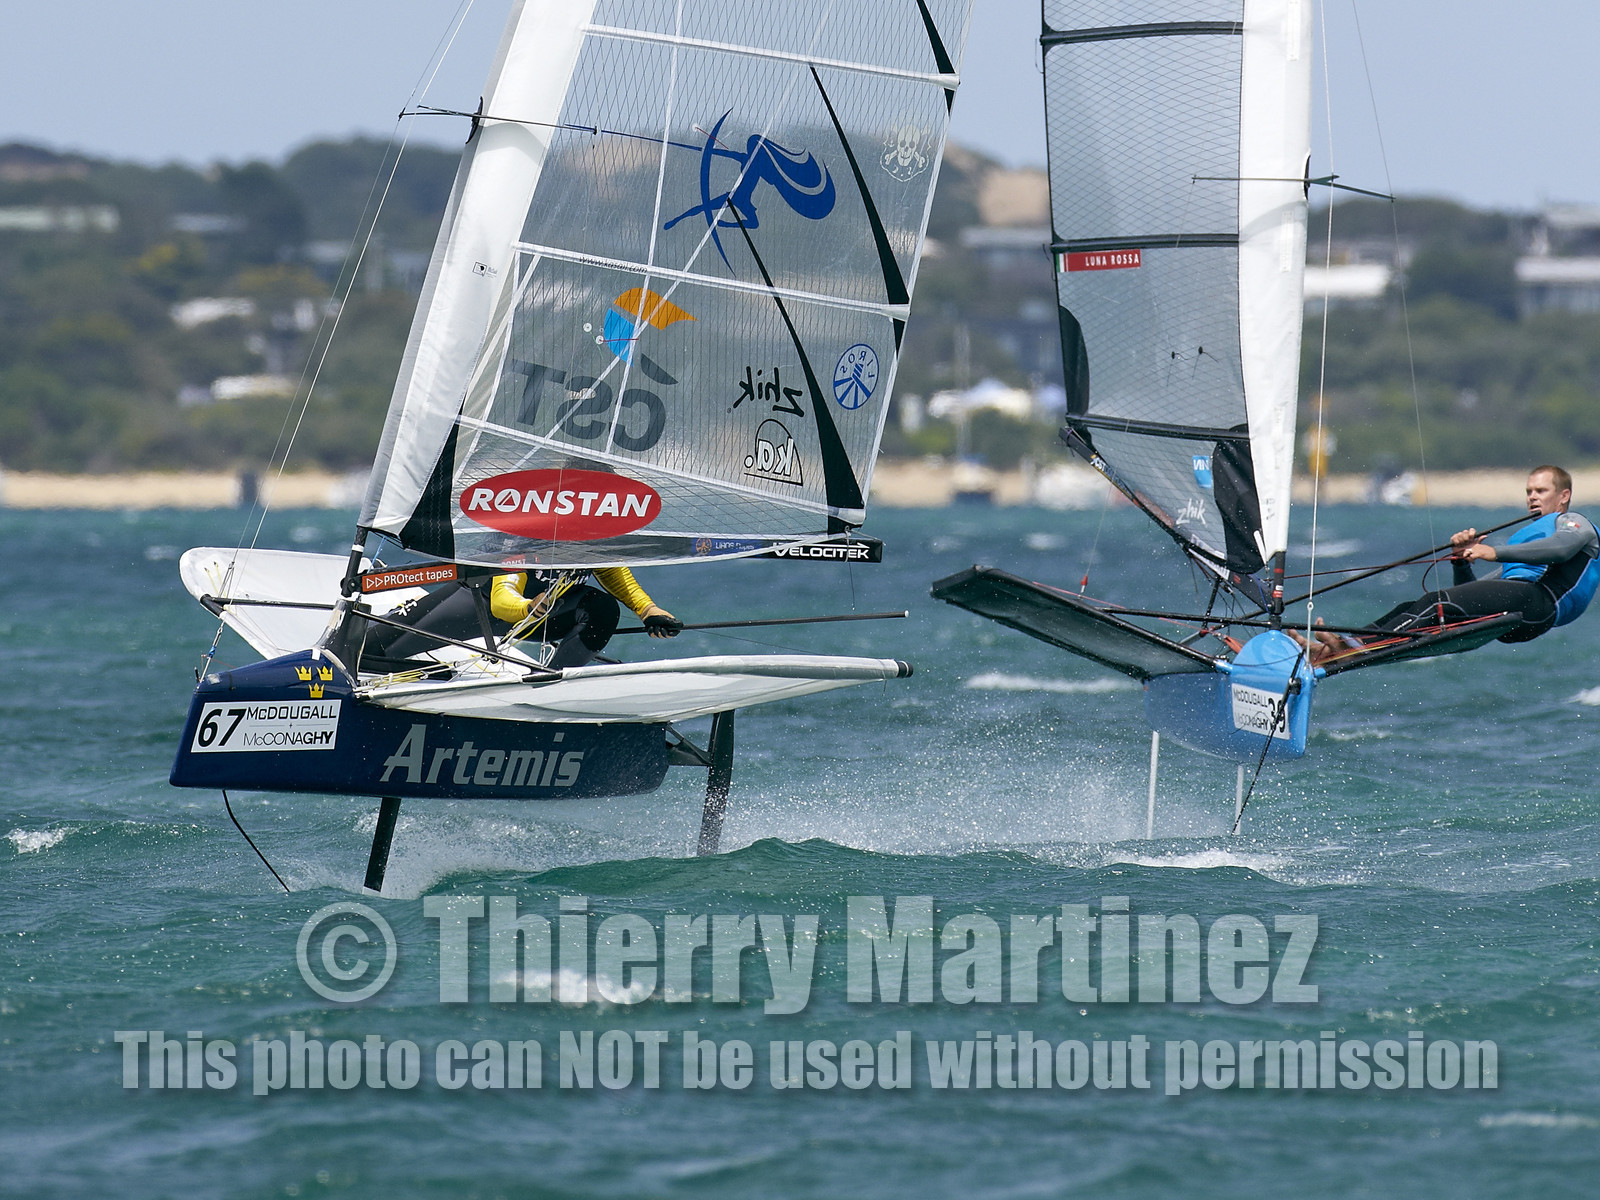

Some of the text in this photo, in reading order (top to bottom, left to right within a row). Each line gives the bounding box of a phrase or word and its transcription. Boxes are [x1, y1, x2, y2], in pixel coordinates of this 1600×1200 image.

[1085, 253, 1139, 266] LUNA ROSSA
[468, 488, 652, 518] RONSTAN
[1175, 498, 1206, 525] zhik
[773, 542, 870, 559] VELOCITEK
[384, 568, 453, 586] PROtect tapes
[246, 706, 337, 721] McDOUGALL
[198, 708, 247, 747] 67
[243, 731, 334, 746] McCONAGHY
[379, 724, 585, 787] Artemis
